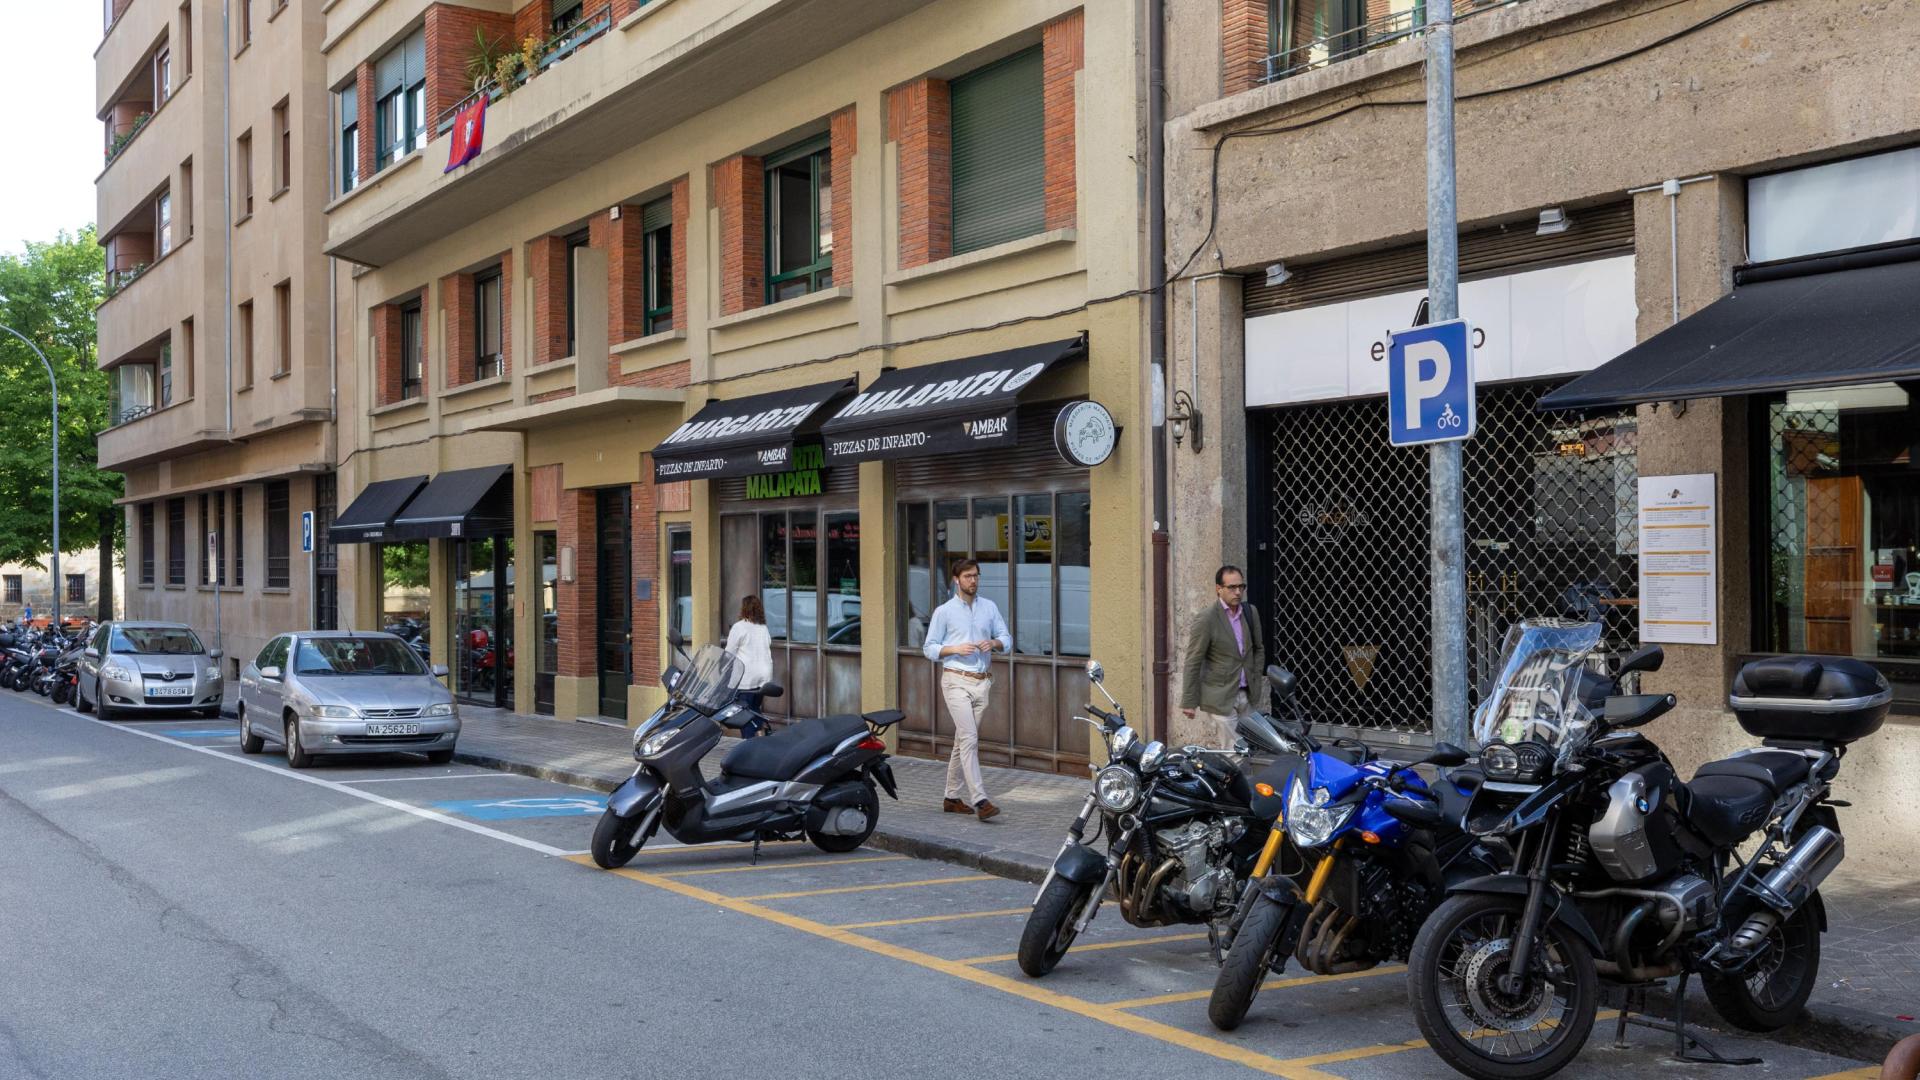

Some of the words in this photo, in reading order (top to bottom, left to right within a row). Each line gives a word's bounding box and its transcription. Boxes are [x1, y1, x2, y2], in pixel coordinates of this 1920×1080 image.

[833, 368, 1014, 419] MALAPATA
[1404, 340, 1451, 430] P
[662, 402, 821, 444] MARGARITA
[971, 416, 1008, 436] AMBAR
[761, 447, 787, 462] AMBAR
[832, 438, 865, 456] PIZZAS
[867, 437, 880, 451] DE
[882, 432, 925, 449] INFARTO
[659, 462, 683, 475] PIZZAS
[683, 461, 692, 473] DE
[694, 458, 724, 472] INFARTO
[746, 470, 822, 499] MALAPATA
[304, 517, 311, 546] P
